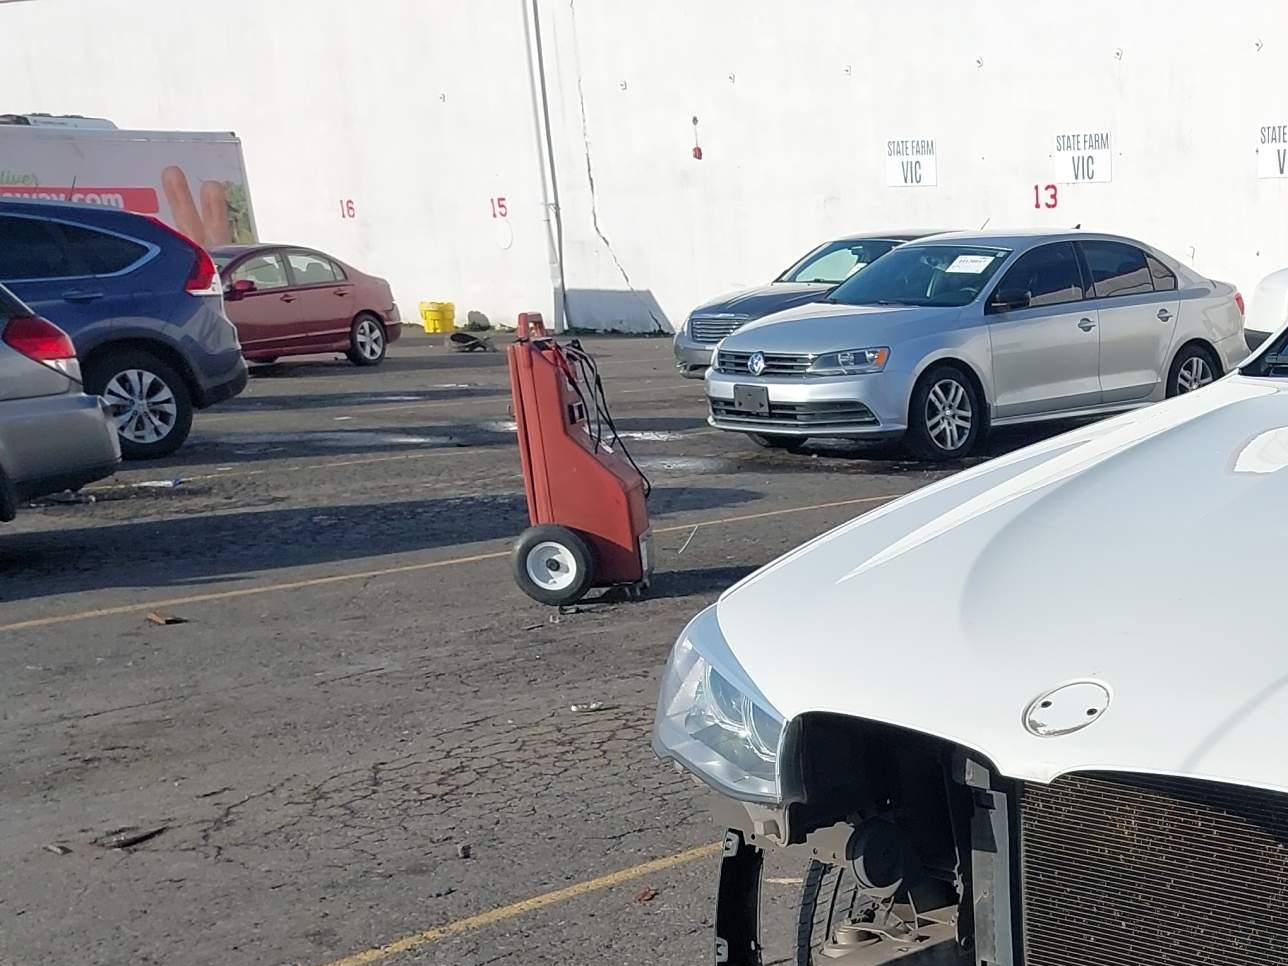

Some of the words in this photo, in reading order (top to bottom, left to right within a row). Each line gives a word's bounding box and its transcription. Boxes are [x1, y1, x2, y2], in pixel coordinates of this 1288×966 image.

[1056, 134, 1081, 152] STATE
[1083, 132, 1110, 150] FARM
[1260, 125, 1287, 144] STATE
[887, 140, 910, 157] STATE
[911, 139, 935, 156] FARM
[901, 160, 922, 184] VIC
[1072, 155, 1095, 180] VIC
[1034, 184, 1058, 209] 13
[340, 199, 356, 218] 16
[490, 197, 508, 218] 15
